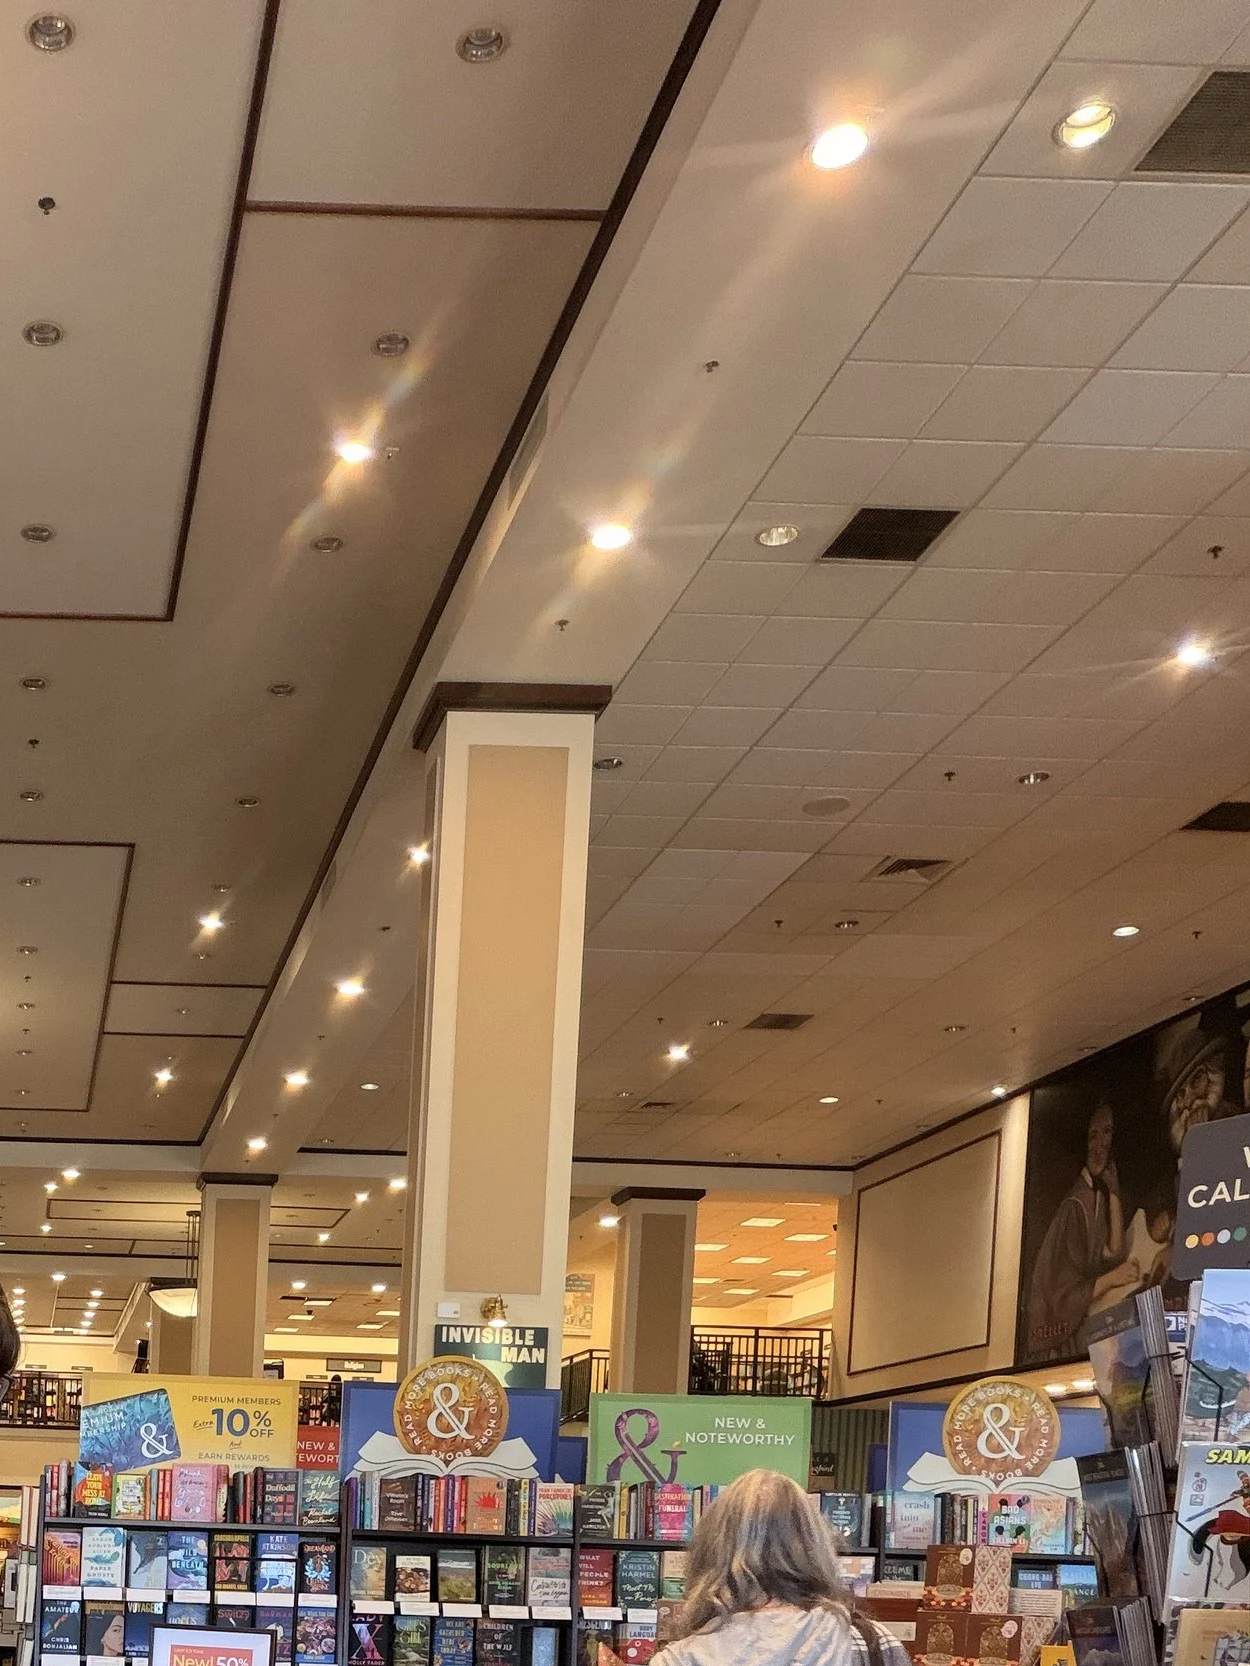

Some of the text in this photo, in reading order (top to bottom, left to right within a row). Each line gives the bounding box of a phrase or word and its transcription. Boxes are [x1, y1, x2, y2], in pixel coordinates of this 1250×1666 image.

[441, 1326, 535, 1346] INVISIBLE
[501, 1347, 545, 1364] MAN
[405, 1366, 471, 1409] MORE BOOKS
[191, 1395, 281, 1406] PREMIUM MEMBERS
[479, 1382, 498, 1414] READ
[953, 1386, 1023, 1430] MORE BOOKS
[714, 1417, 766, 1429] NEW &
[250, 1428, 275, 1439] OFF
[404, 1414, 423, 1447] READ
[474, 1419, 497, 1450] MORE
[685, 1432, 795, 1446] NOTEWORTHY
[981, 1402, 1049, 1480] READ MORE BOOKS
[297, 1441, 336, 1451] NEW &
[953, 1435, 972, 1467] READ
[198, 1452, 270, 1462] EARN REWARDS
[265, 1484, 296, 1492] Daffodil
[904, 1501, 930, 1510] crash
[1001, 1505, 1020, 1515] BAD
[900, 1514, 919, 1522] into
[994, 1515, 1027, 1525] ASIANS
[621, 1571, 656, 1579] HARMEL
[483, 1623, 514, 1631] CHILDREN
[351, 1623, 384, 1660] X
